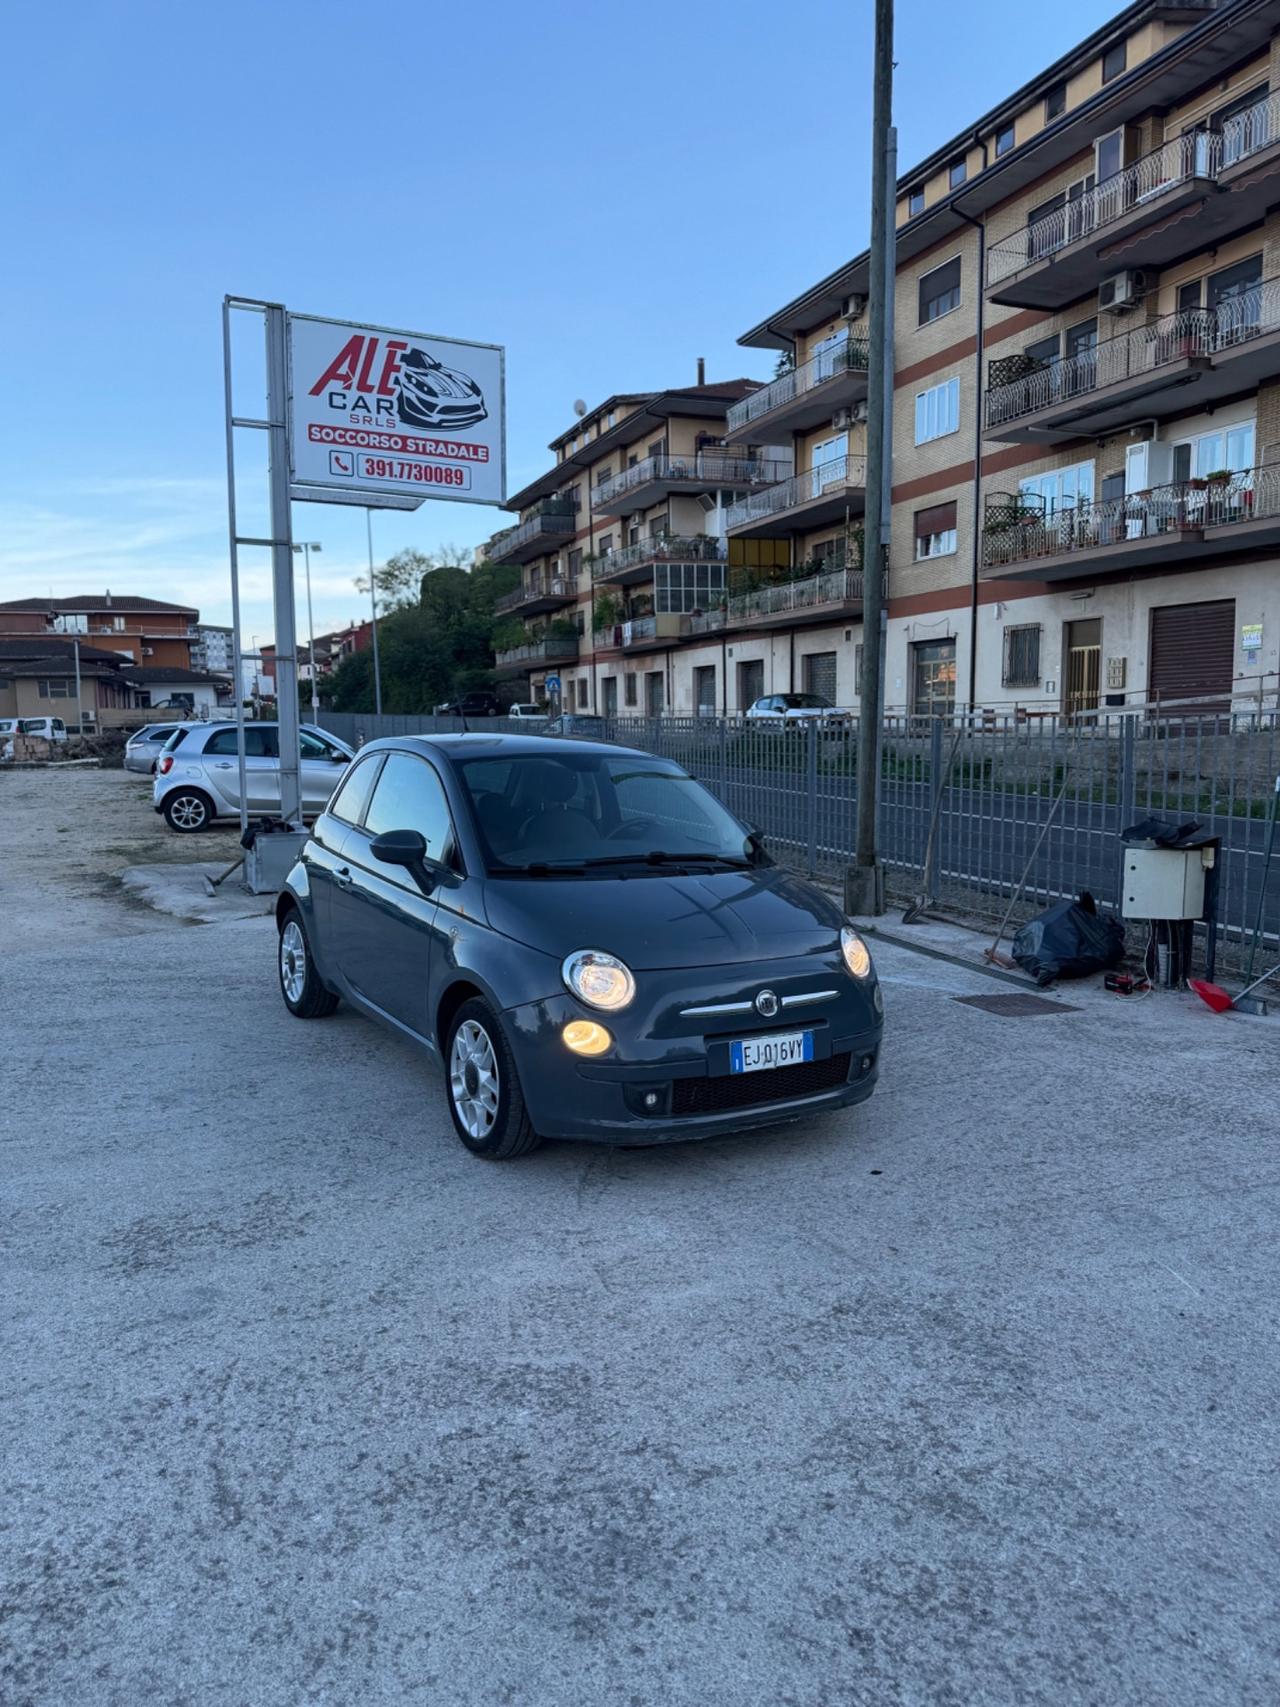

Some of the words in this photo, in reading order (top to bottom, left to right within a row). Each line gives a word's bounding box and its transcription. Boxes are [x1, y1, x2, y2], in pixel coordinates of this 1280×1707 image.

[308, 334, 408, 396] ALE
[329, 392, 394, 416] CAR
[349, 414, 396, 428] SRLS
[310, 427, 402, 449] SOCCORSO
[406, 439, 487, 460] STRADALE
[365, 458, 463, 485] 391.7730089
